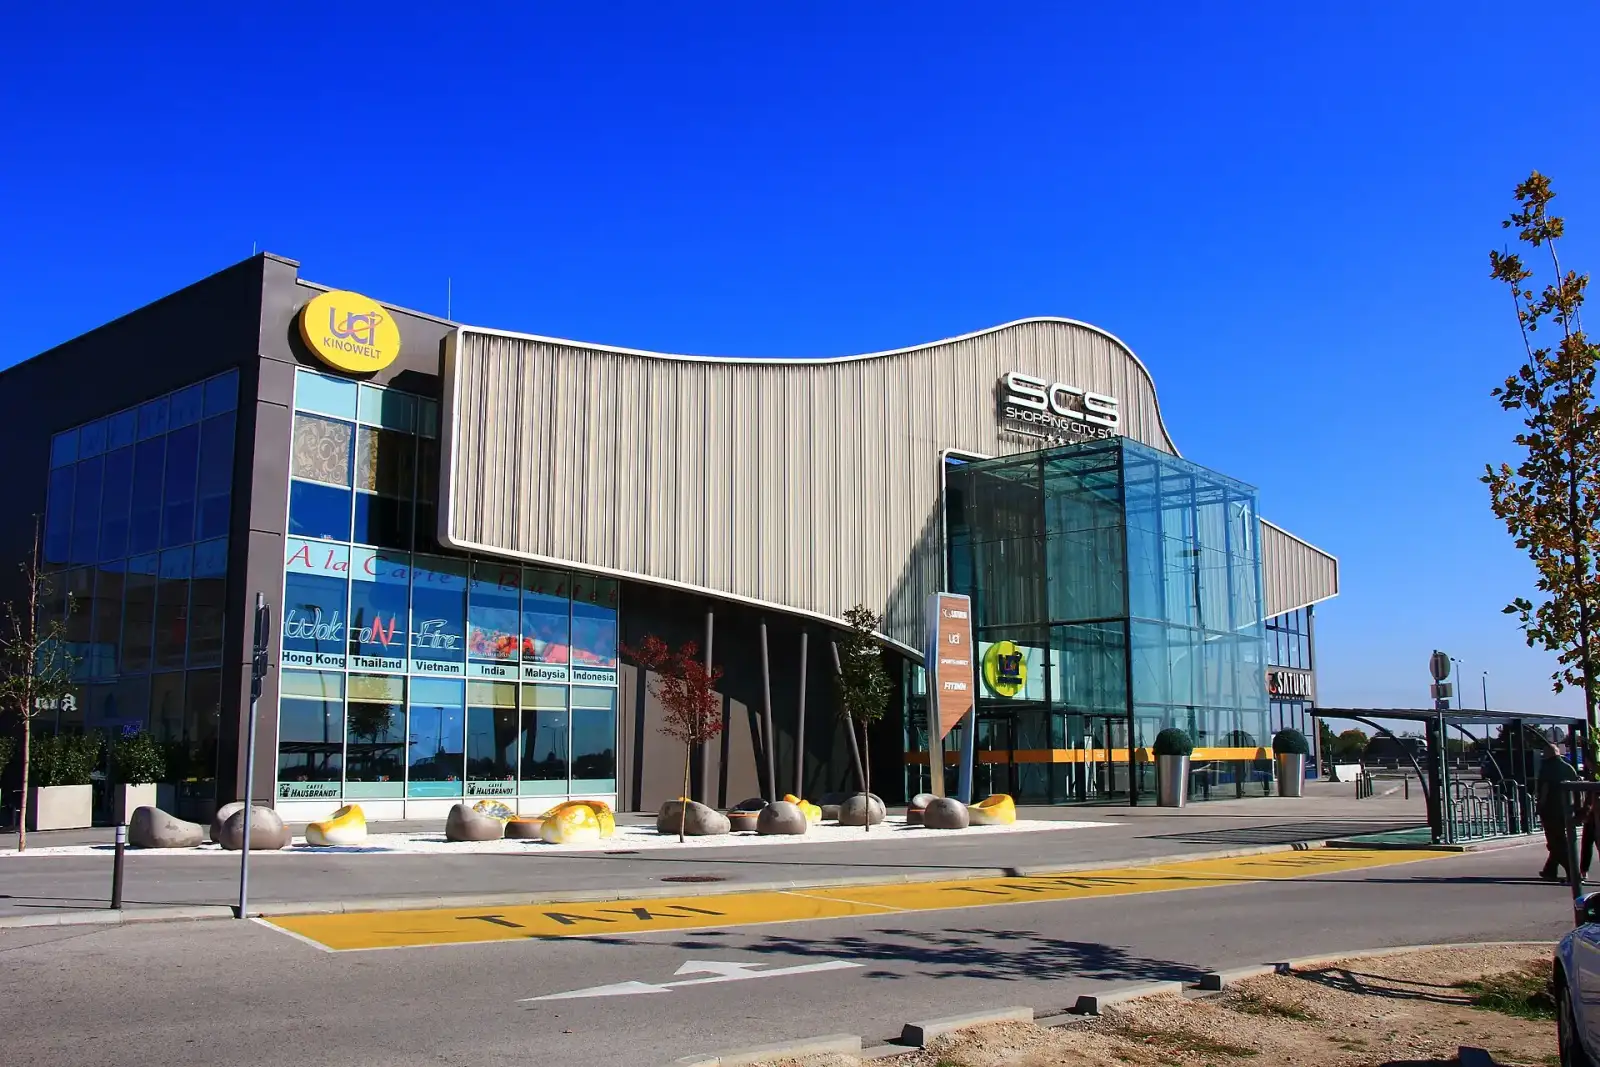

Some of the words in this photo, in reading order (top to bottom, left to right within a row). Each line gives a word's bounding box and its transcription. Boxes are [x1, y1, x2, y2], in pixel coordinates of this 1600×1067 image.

[323, 336, 382, 360] KINOWELT
[1007, 371, 1120, 429] SCS
[1005, 406, 1069, 433] SHOPPING
[1071, 421, 1096, 438] CITY
[324, 549, 348, 572] la
[363, 555, 449, 585] Carte
[284, 607, 343, 642] Wok
[416, 618, 457, 649] Fire
[282, 651, 313, 666] Hong
[315, 653, 346, 668] Kong
[353, 657, 402, 669] Thailand
[416, 661, 460, 673] Vietnam
[481, 665, 506, 676] India
[525, 668, 566, 680] Malaysia
[573, 671, 615, 682] Indonesia
[1277, 671, 1312, 696] SATURN
[290, 788, 338, 798] HAUSBRANDT
[475, 787, 514, 796] HAUSBRANDT
[455, 904, 728, 928] TAXI
